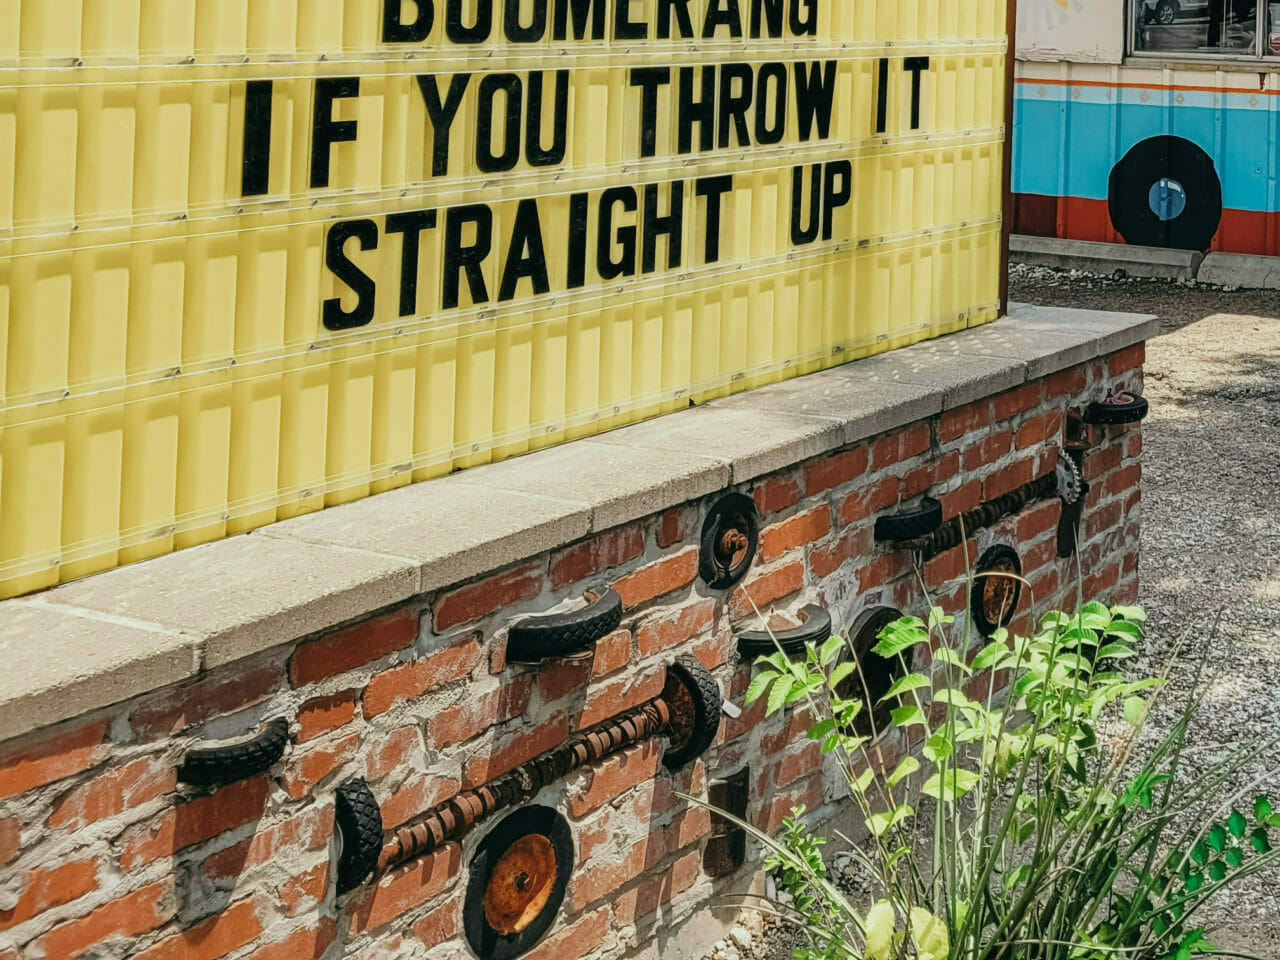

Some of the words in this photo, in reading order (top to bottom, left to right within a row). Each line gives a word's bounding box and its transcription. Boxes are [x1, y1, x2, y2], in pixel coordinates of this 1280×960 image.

[242, 77, 360, 197] IF
[415, 69, 569, 177] YOU
[629, 59, 837, 158] THROW
[875, 56, 930, 133] IT
[322, 175, 732, 331] STRAIGHT
[790, 159, 852, 246] UP
